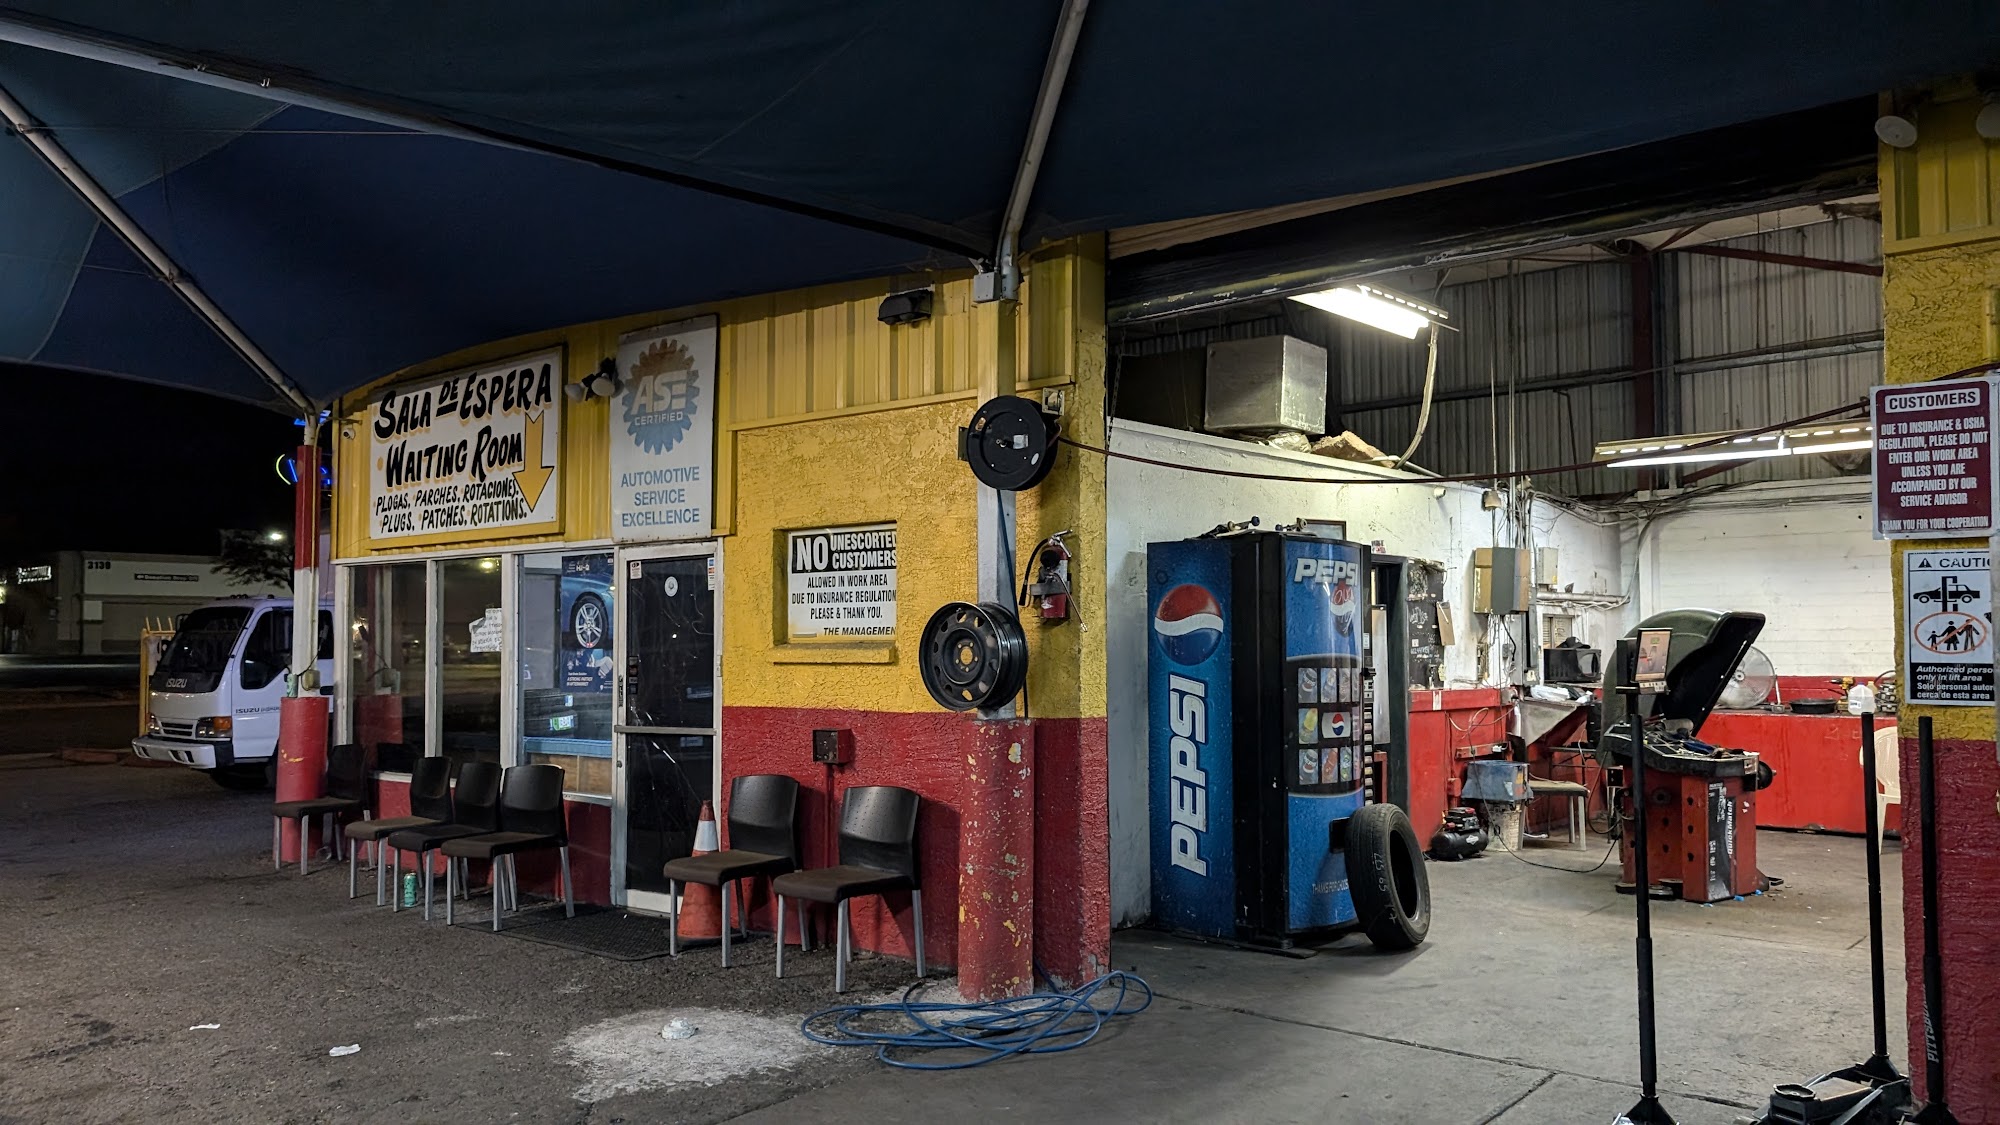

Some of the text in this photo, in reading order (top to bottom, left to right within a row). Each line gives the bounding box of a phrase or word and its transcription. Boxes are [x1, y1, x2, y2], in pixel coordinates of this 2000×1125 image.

[631, 369, 688, 415] ASE
[1889, 391, 1976, 410] CUSTOMERS
[374, 363, 552, 439] SALA DE ESPERA
[634, 410, 684, 426] CERTIFIED
[1881, 416, 1985, 436] DUE TO INSURANCE & OSHA
[1878, 431, 1989, 450] REGULATION, PLEASE DO NOT
[386, 438, 468, 488] WAITING
[470, 424, 523, 483] ROOM
[1888, 447, 1979, 464] ENTER OUR WORK AREA
[620, 466, 700, 488] AUTOMOTIVE
[1901, 462, 1966, 478] UNLESS YOU ARE
[1890, 477, 1977, 493] ACCOMPANIED BY OUR
[634, 488, 685, 506] SERVICE
[1900, 492, 1968, 507] SERVICE ADVISOR
[470, 497, 527, 527] ROTATIONS.
[622, 507, 700, 528] EXCELLENCE
[1881, 516, 1989, 531] THANK YOU FOR YOUR COOPERATION
[796, 535, 829, 571] NO
[1939, 557, 1990, 568] CAUTI
[1293, 557, 1358, 586] PEPSI
[807, 574, 888, 588] ALLOWED IN WORK AREA
[792, 592, 804, 604] DUE
[806, 592, 814, 604] TO
[816, 591, 853, 604] INSURANCE
[810, 606, 882, 620] PLEASE & THANK YOU.
[824, 628, 840, 636] THE
[165, 678, 188, 688] ISUZU
[1916, 682, 1934, 690] Solo
[1936, 683, 1970, 691] personal
[1169, 674, 1207, 877] PEPSI
